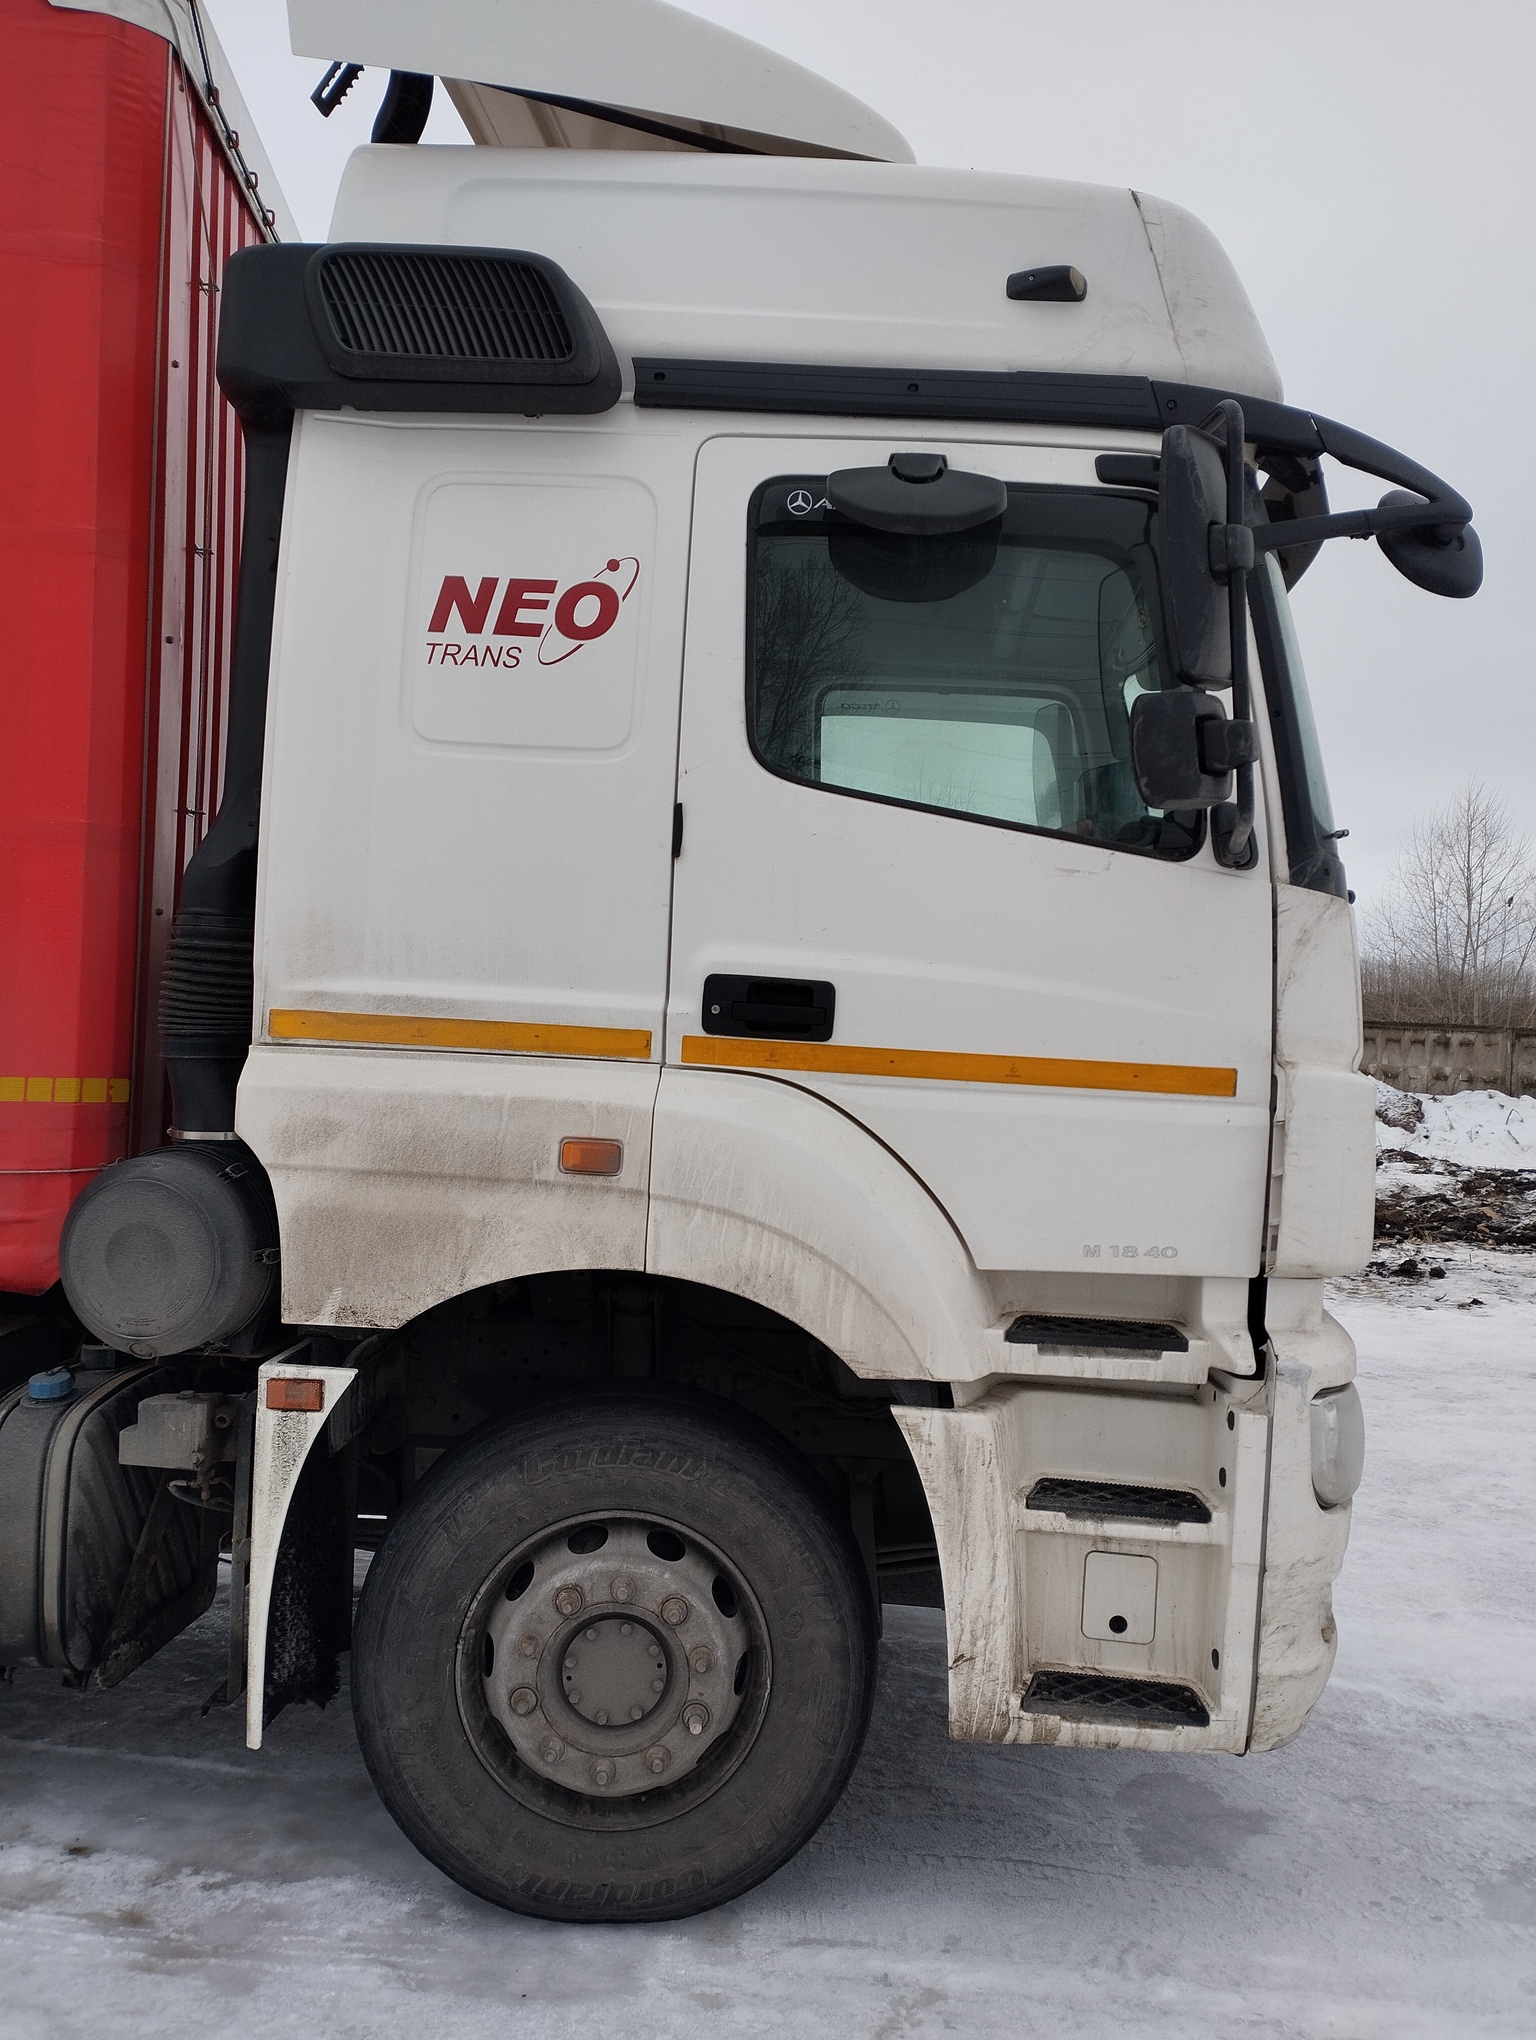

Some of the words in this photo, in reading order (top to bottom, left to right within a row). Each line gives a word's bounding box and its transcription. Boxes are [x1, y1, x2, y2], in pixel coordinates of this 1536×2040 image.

[427, 575, 620, 641] NEO
[426, 642, 523, 669] TRANS
[1083, 1244, 1101, 1258] M
